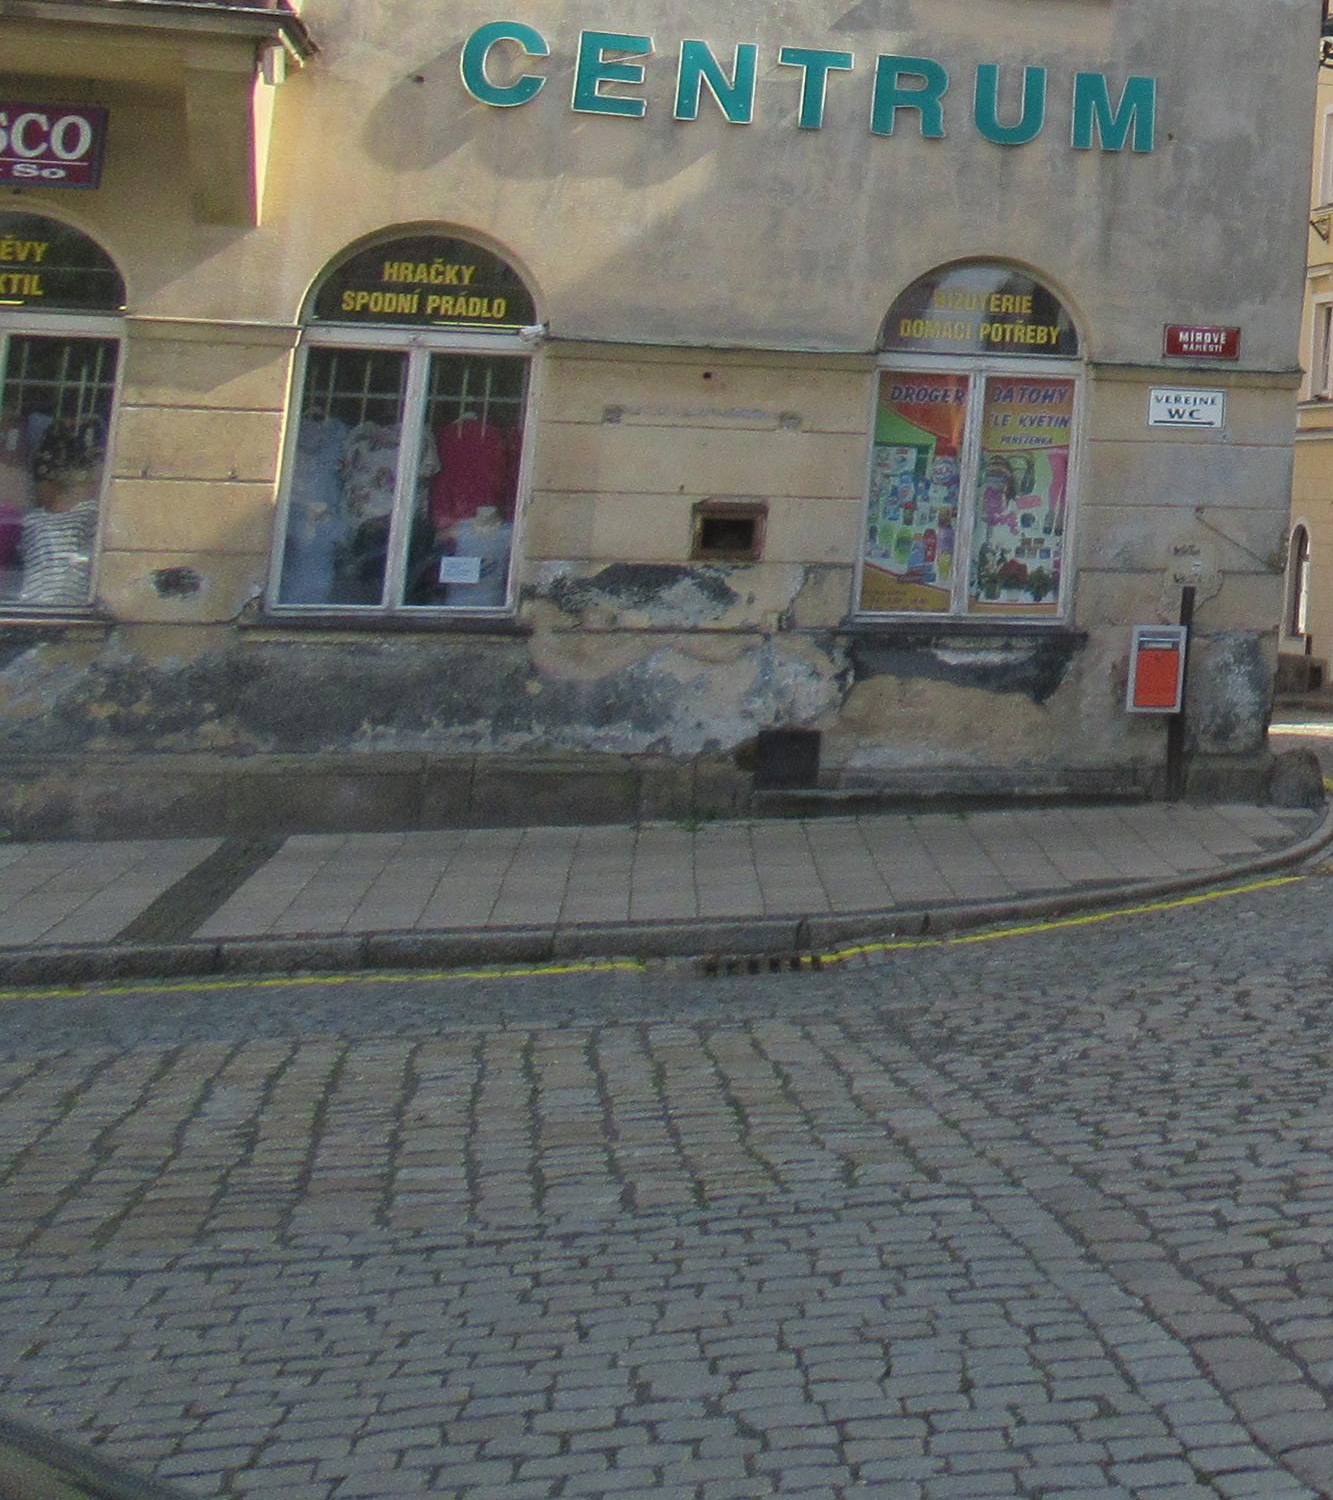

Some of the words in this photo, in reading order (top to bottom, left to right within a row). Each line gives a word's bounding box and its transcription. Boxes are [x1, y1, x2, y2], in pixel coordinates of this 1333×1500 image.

[460, 20, 1157, 154] CENTRUM
[0, 111, 93, 160] CO
[383, 257, 477, 286] HRAČKY
[341, 288, 421, 314] SPODNÍ
[425, 291, 507, 319] PRÁDLO
[978, 319, 1061, 345] POTŘEBY
[1178, 330, 1227, 345] MÍROVÉ
[1167, 408, 1202, 420] WC
